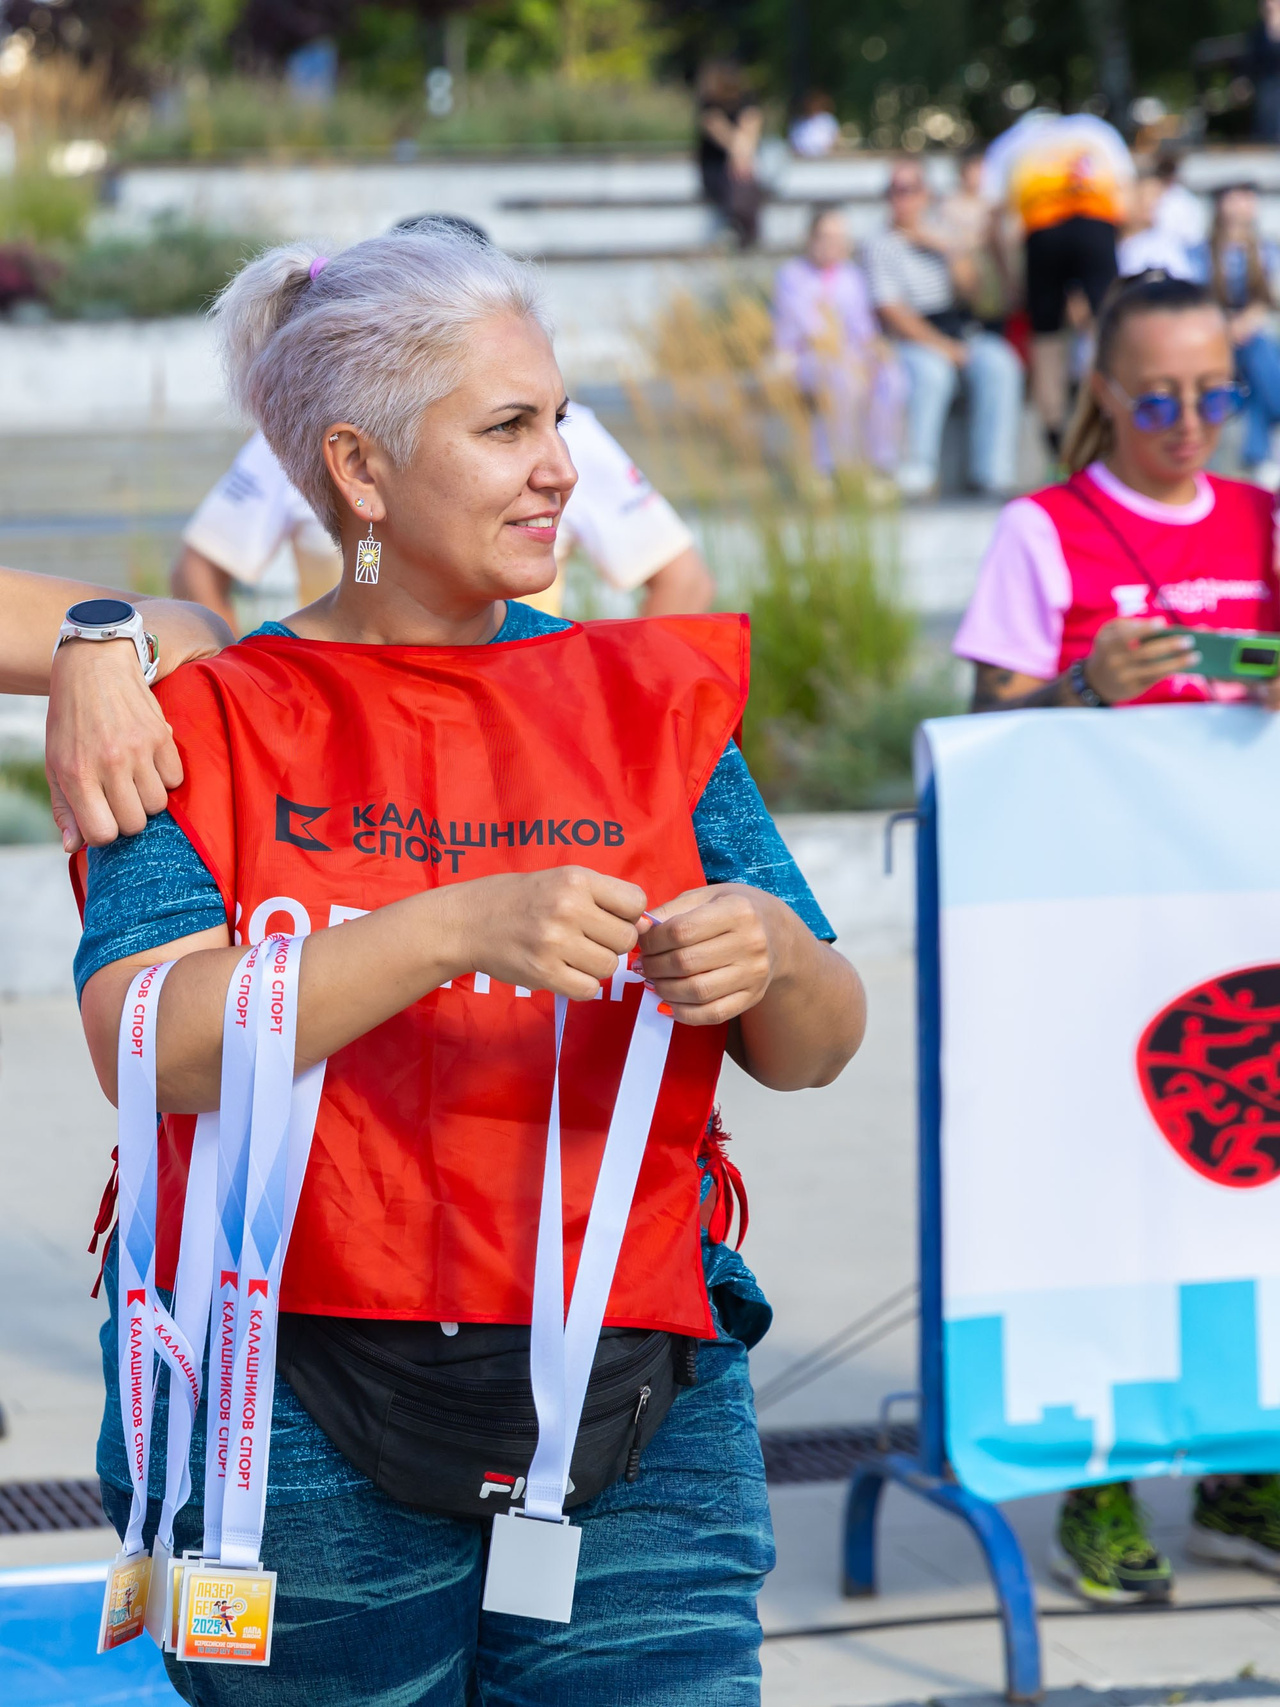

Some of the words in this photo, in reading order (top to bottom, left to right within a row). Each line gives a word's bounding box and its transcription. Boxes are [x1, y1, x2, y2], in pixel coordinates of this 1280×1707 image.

[352, 802, 626, 848] КАЛАШНИКОВ
[352, 830, 467, 874] СПОРТ
[235, 973, 252, 1028] СПОРТ
[269, 980, 285, 1035] СПОРТ
[131, 1003, 146, 1058] СПОРТ
[130, 1317, 143, 1428] КАЛАШНИКОВ
[219, 1300, 235, 1421] КАЛАШНИКОВ
[241, 1309, 263, 1430] КАЛАШНИКОВ
[133, 1432, 145, 1482] СПОРТ
[237, 1436, 254, 1491] СПОРТ
[196, 1582, 234, 1599] ЛАЗЕР
[192, 1618, 221, 1635] 2025
